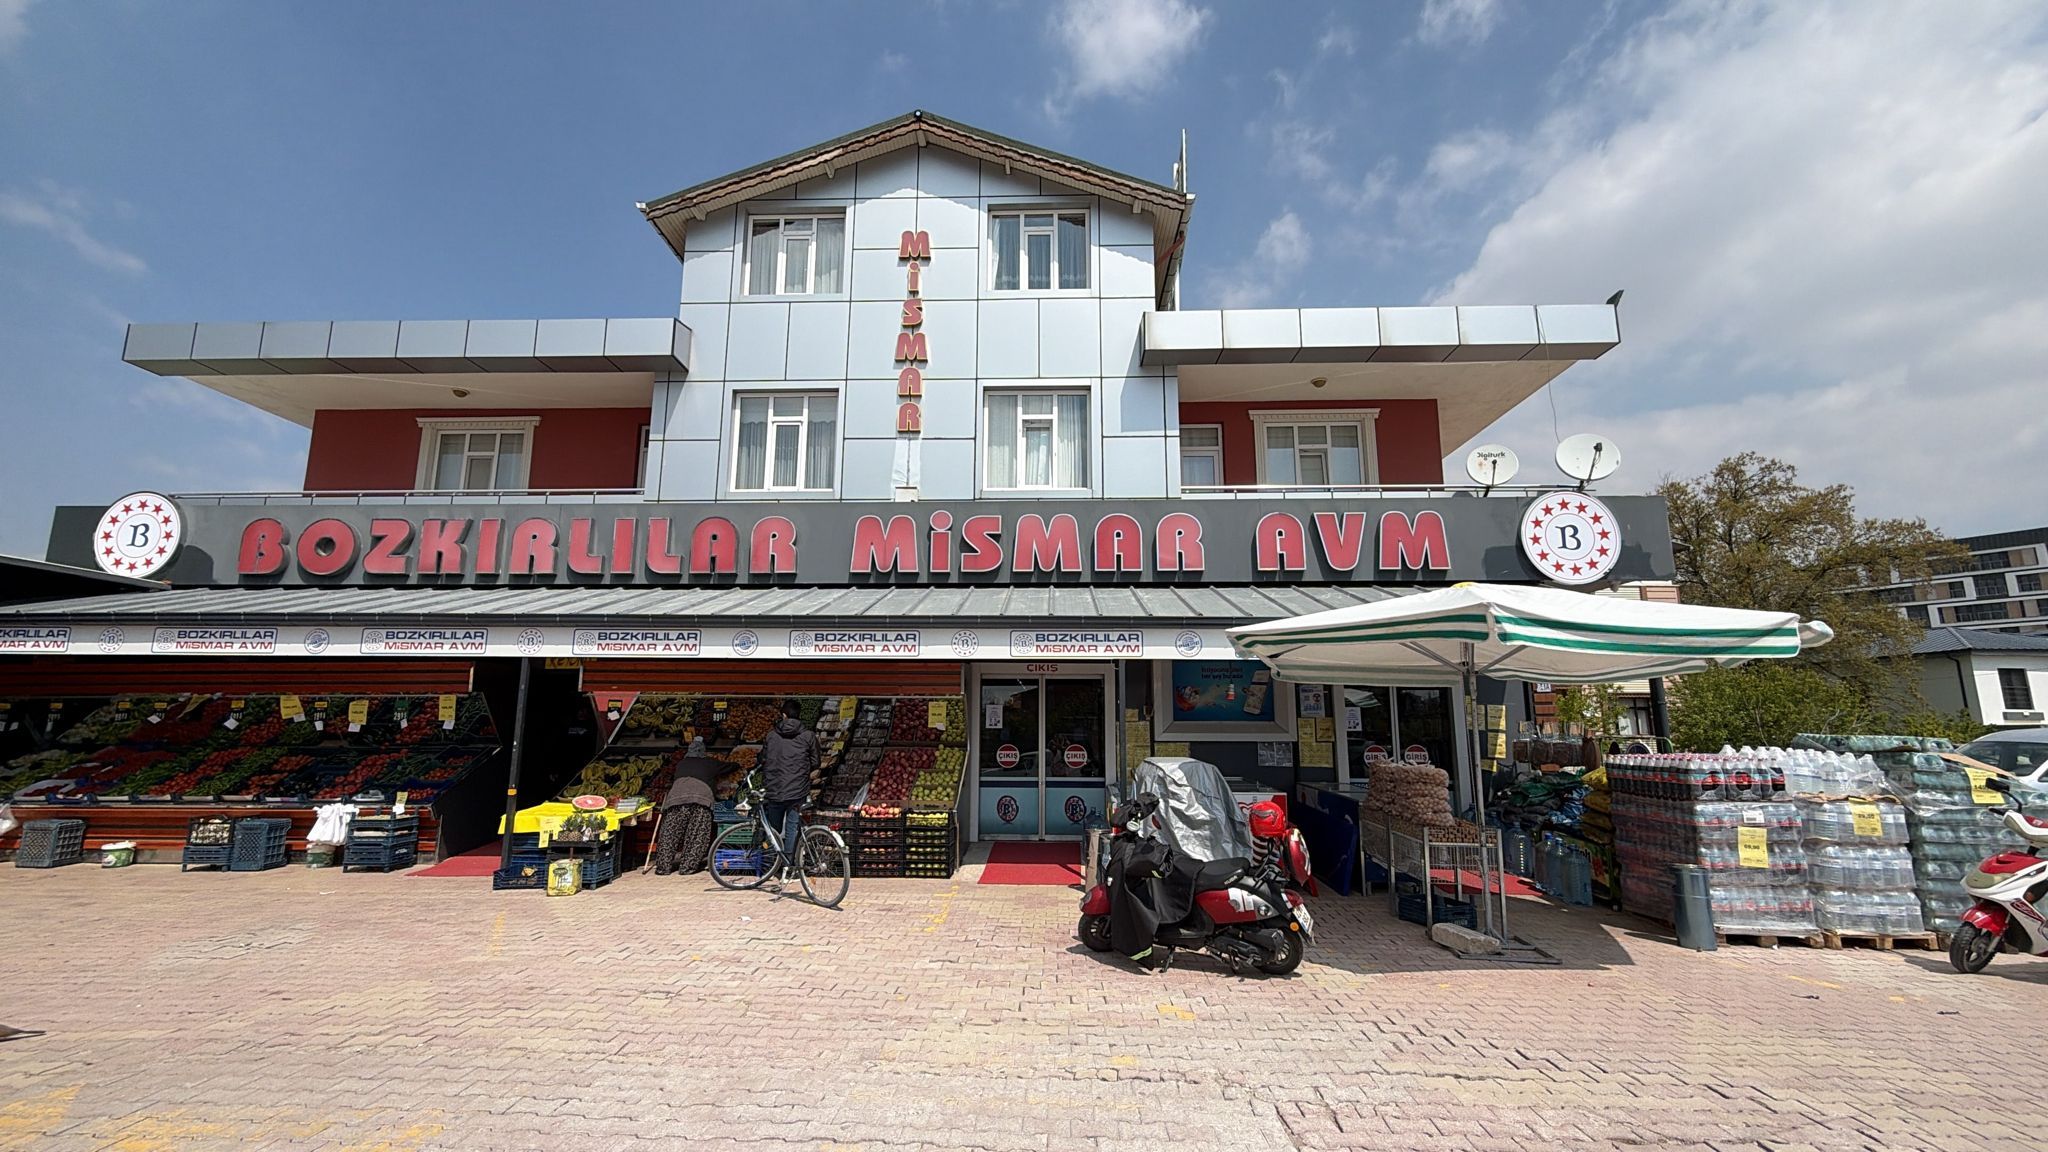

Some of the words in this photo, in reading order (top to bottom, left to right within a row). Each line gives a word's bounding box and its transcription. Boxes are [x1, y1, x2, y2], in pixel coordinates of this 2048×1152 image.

[127, 523, 149, 548] B
[1555, 524, 1582, 551] B
[237, 515, 797, 576] BOZKIRLILAR
[1255, 511, 1452, 572] AVM
[177, 630, 274, 640] BOZKIRLILAR
[385, 631, 485, 640] BOZKIRLILAR
[597, 632, 698, 641] BOZKIRLILAR
[814, 633, 917, 642] BOZKIRLILAR
[1035, 633, 1140, 642] BOZKIRLILAR
[31, 640, 66, 649] AVM
[238, 641, 273, 650] AVM
[448, 641, 484, 650] AVM
[662, 643, 697, 652] AVM
[881, 644, 916, 653] AVM
[1103, 644, 1140, 653] AVM
